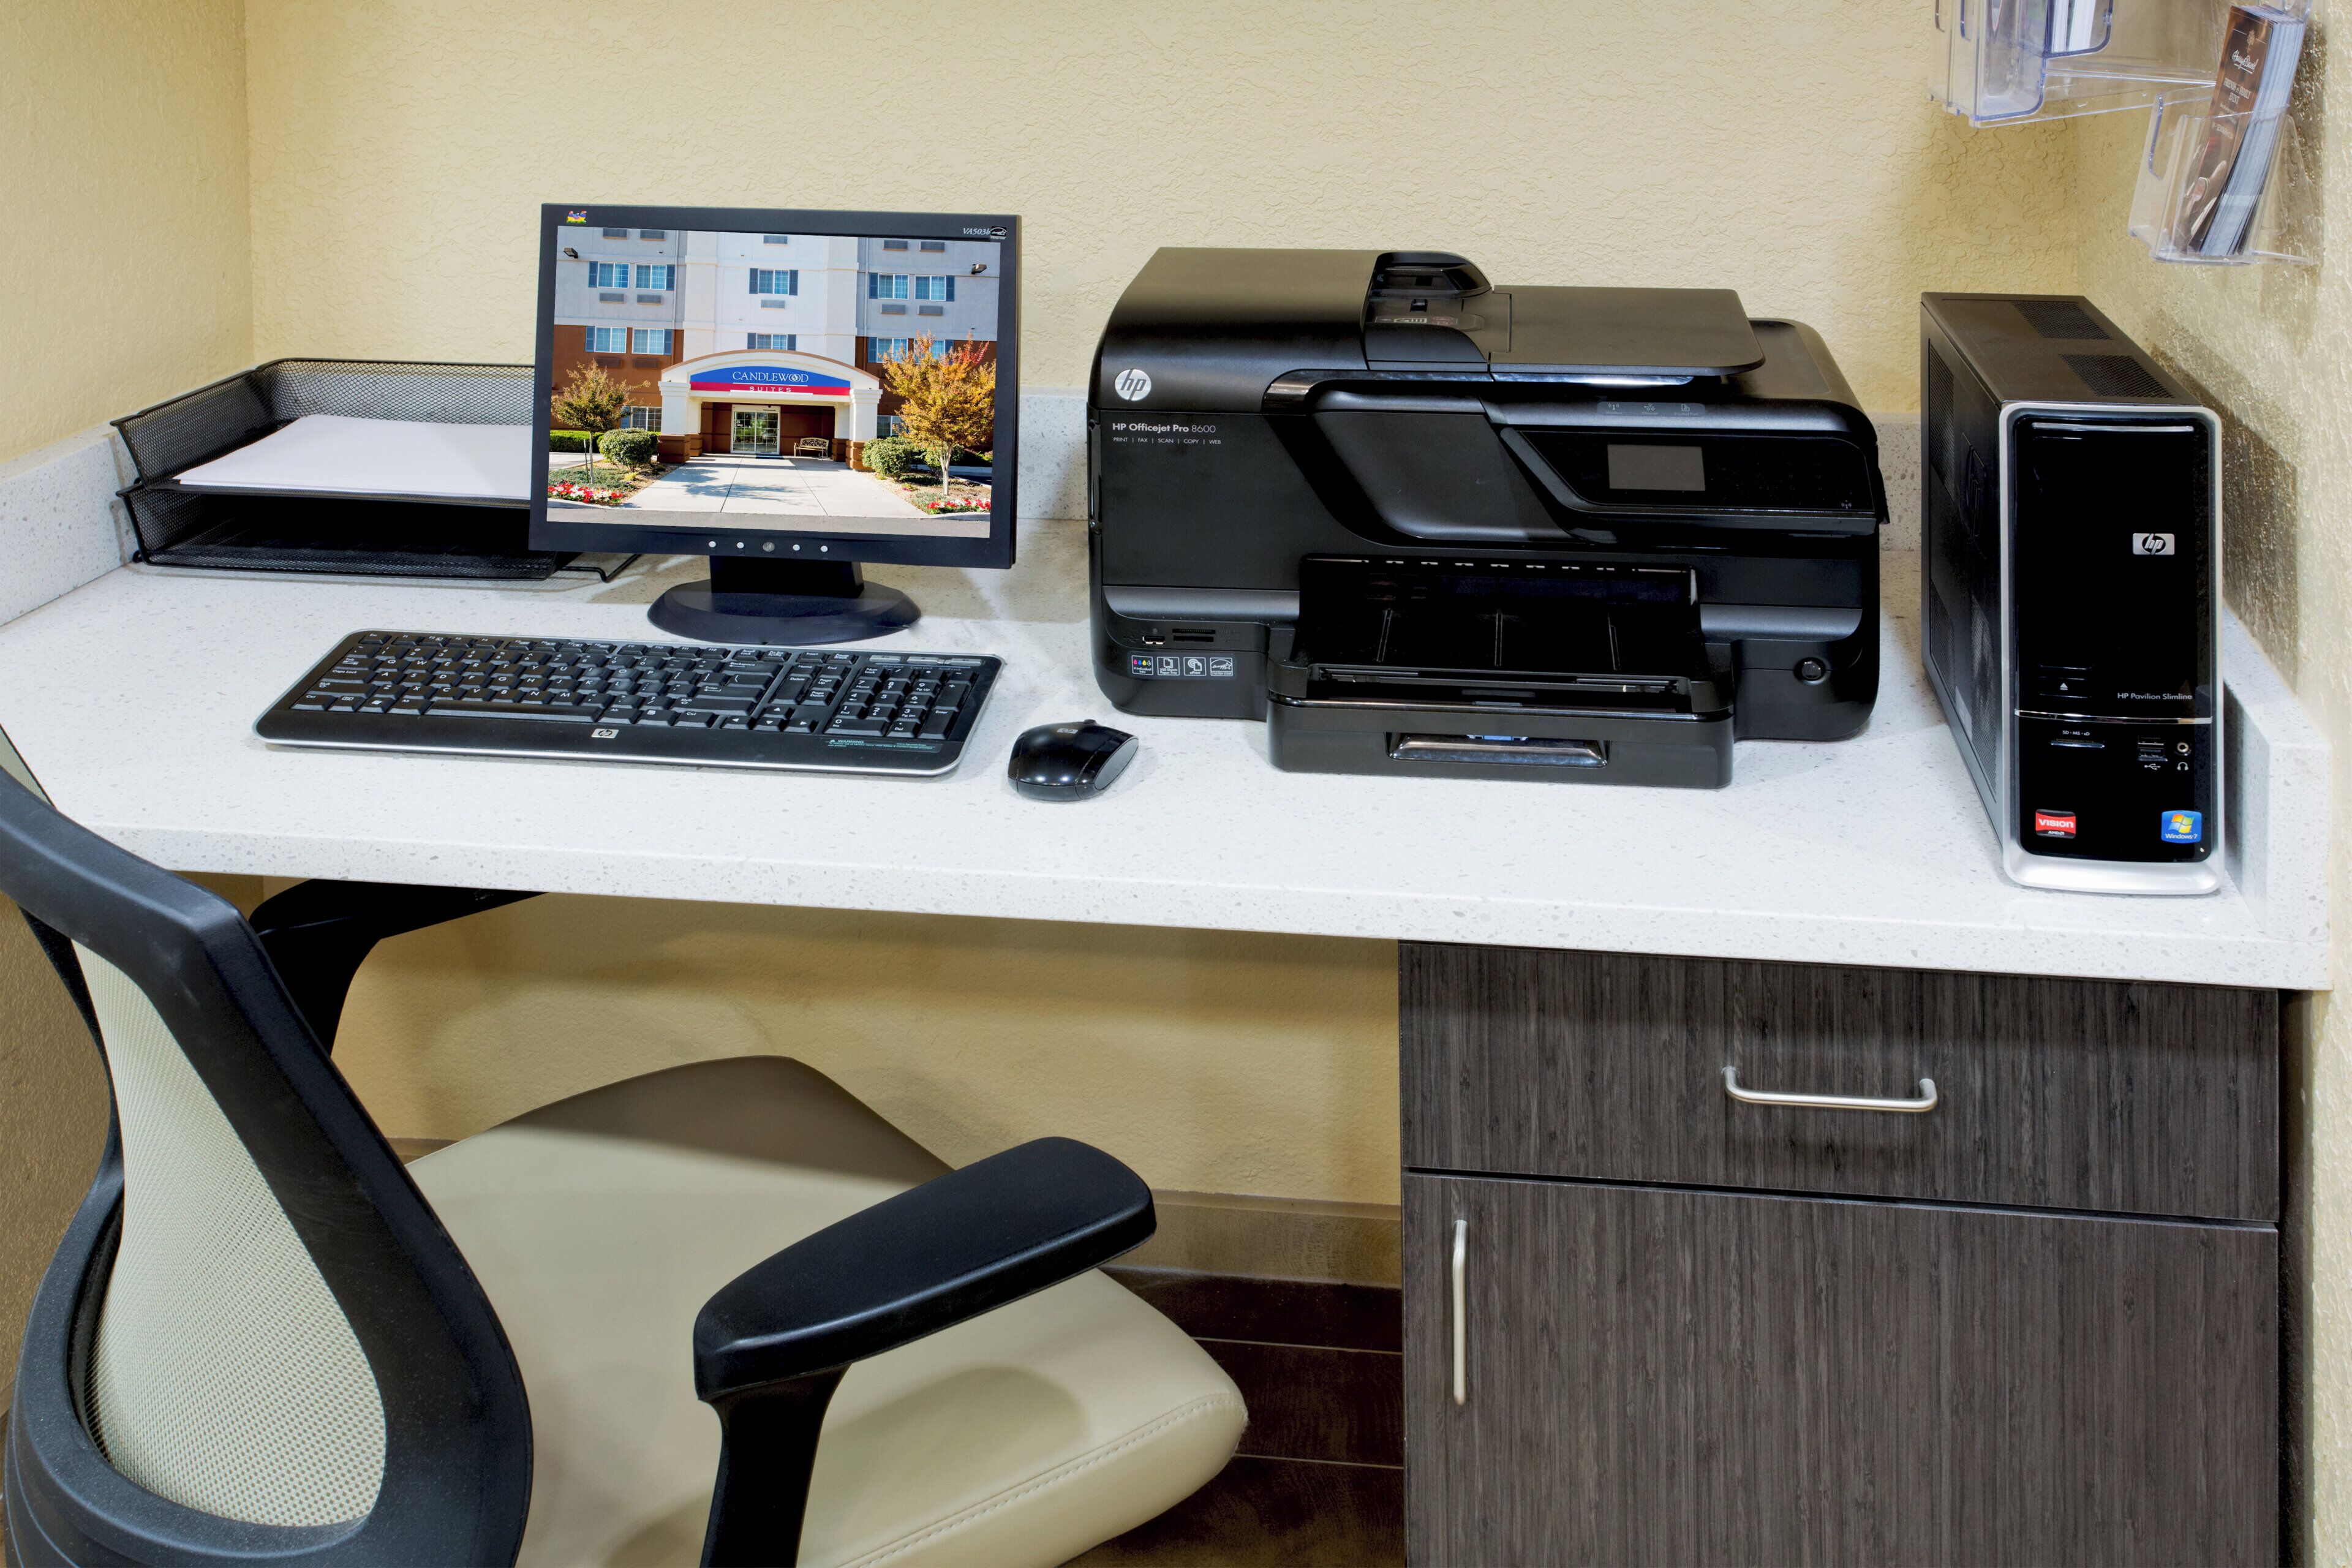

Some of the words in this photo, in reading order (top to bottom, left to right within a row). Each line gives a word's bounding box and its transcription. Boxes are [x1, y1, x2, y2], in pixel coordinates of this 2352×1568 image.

[2229, 92, 2240, 105] EVENT
[733, 372, 809, 382] CANDLEWOOD
[1120, 369, 1147, 400] hp
[1129, 423, 1170, 433] Officejet
[2144, 533, 2164, 555] hp
